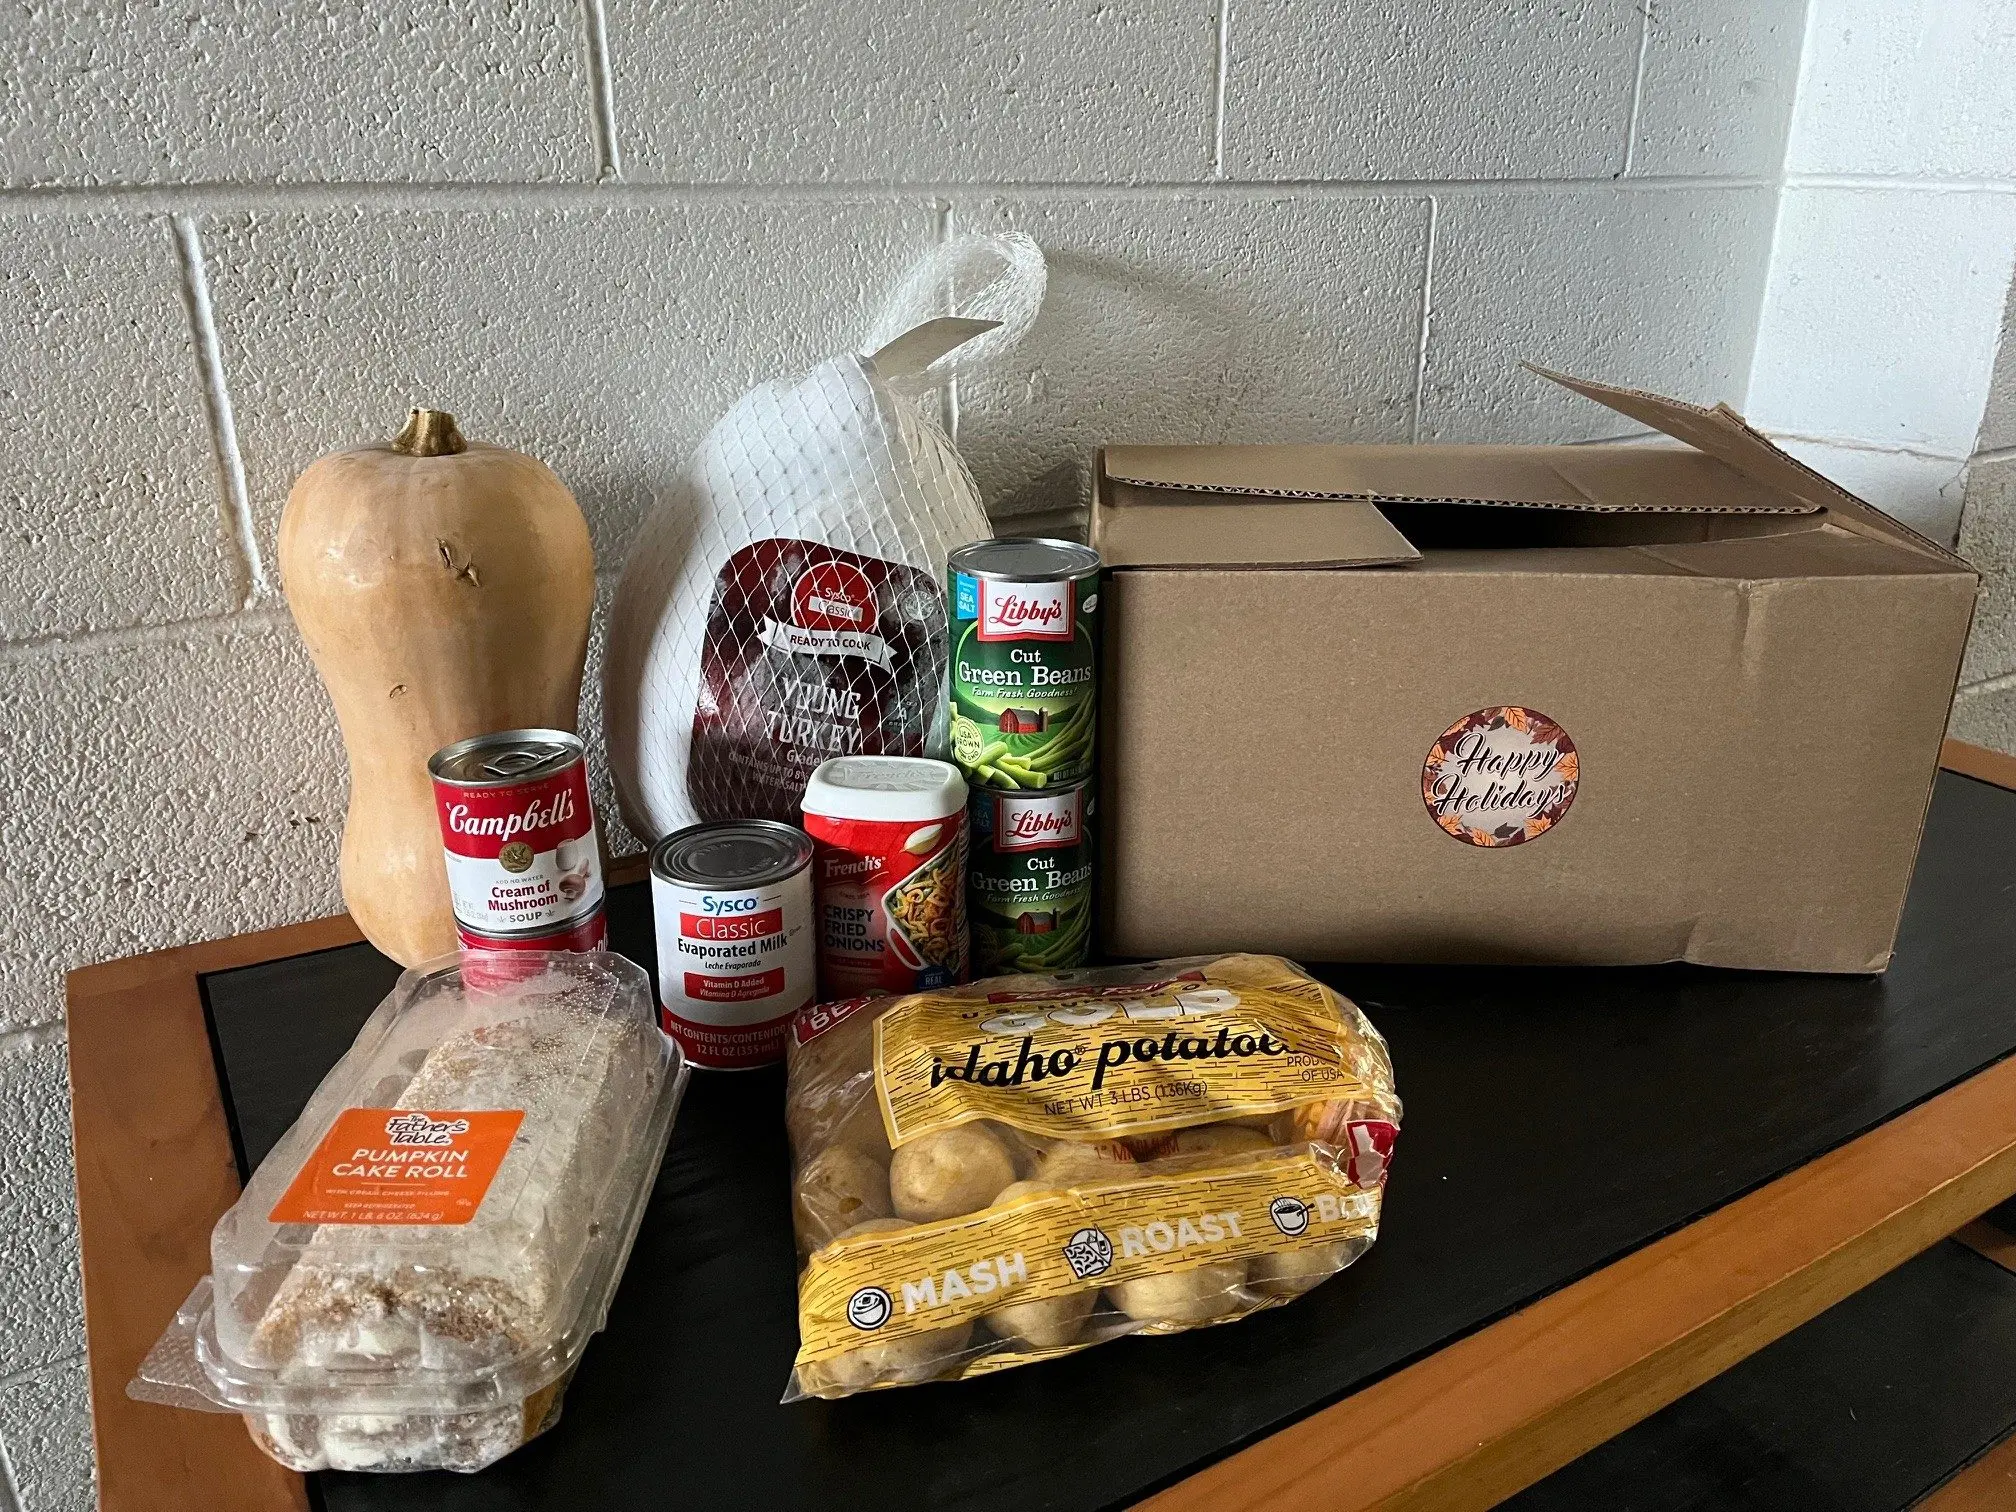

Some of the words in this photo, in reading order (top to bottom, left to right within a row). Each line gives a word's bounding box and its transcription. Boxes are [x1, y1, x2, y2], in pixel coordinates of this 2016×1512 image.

[824, 587, 852, 601] Sysco
[960, 593, 974, 604] SEA
[818, 601, 854, 619] Classic
[958, 601, 976, 613] SALT
[988, 594, 1063, 627] Libby's
[789, 634, 824, 648] READY
[825, 637, 840, 648] TO
[842, 638, 872, 651] COOK
[1010, 649, 1041, 663] Cut
[958, 661, 1023, 686] Green
[1030, 665, 1092, 687] Beans
[782, 673, 862, 720] YOUNG
[971, 686, 995, 698] Farm
[996, 687, 1024, 699] Fresh
[767, 711, 862, 755] TURKEY
[1453, 733, 1566, 782] Happy
[463, 791, 496, 800] READY
[1431, 773, 1573, 819] Holidays
[445, 788, 575, 842] Campbell's
[1004, 809, 1073, 839] Libby's
[823, 854, 883, 878] French's
[1027, 857, 1055, 871] Cut
[971, 871, 1039, 892] Green
[1045, 862, 1093, 890] Beans
[491, 884, 535, 899] Cream
[537, 879, 551, 893] of
[488, 893, 559, 912] Mushroom
[702, 895, 758, 916] Sysco
[986, 893, 1010, 904] Farm
[1012, 894, 1039, 904] Fresh
[509, 911, 543, 923] SOUP
[822, 904, 875, 923] CRISPY
[696, 917, 766, 939] Classic
[824, 918, 867, 937] FRIED
[677, 937, 756, 960] Evaporated
[760, 933, 788, 954] Milk
[823, 934, 885, 952] ONIONS
[704, 961, 724, 970] Leche
[702, 979, 733, 989] Vitamin
[734, 980, 740, 988] D
[741, 977, 765, 987] Added
[699, 988, 730, 998] Vitamina
[731, 990, 737, 998] D
[670, 1019, 683, 1034] NET
[696, 1043, 707, 1055] 12
[709, 1046, 720, 1056] FL
[722, 1046, 736, 1057] OZ
[930, 1036, 1082, 1089] idaho
[1091, 1027, 1299, 1091] potatoe
[1301, 1069, 1319, 1083] OF
[1321, 1067, 1345, 1081] USA
[1044, 1099, 1074, 1117] NET
[1079, 1093, 1106, 1111] WT
[1109, 1090, 1119, 1106] 3
[1121, 1086, 1151, 1103] LBS
[388, 1118, 467, 1132] Father's
[392, 1131, 447, 1144] Table
[351, 1149, 469, 1163] PUMPKIN
[332, 1164, 402, 1178] CAKE
[404, 1165, 468, 1178] ROLL
[302, 1210, 326, 1219] NET
[376, 1211, 384, 1220] 6
[1119, 1211, 1246, 1260] ROAST
[900, 1252, 1028, 1314] MASH
